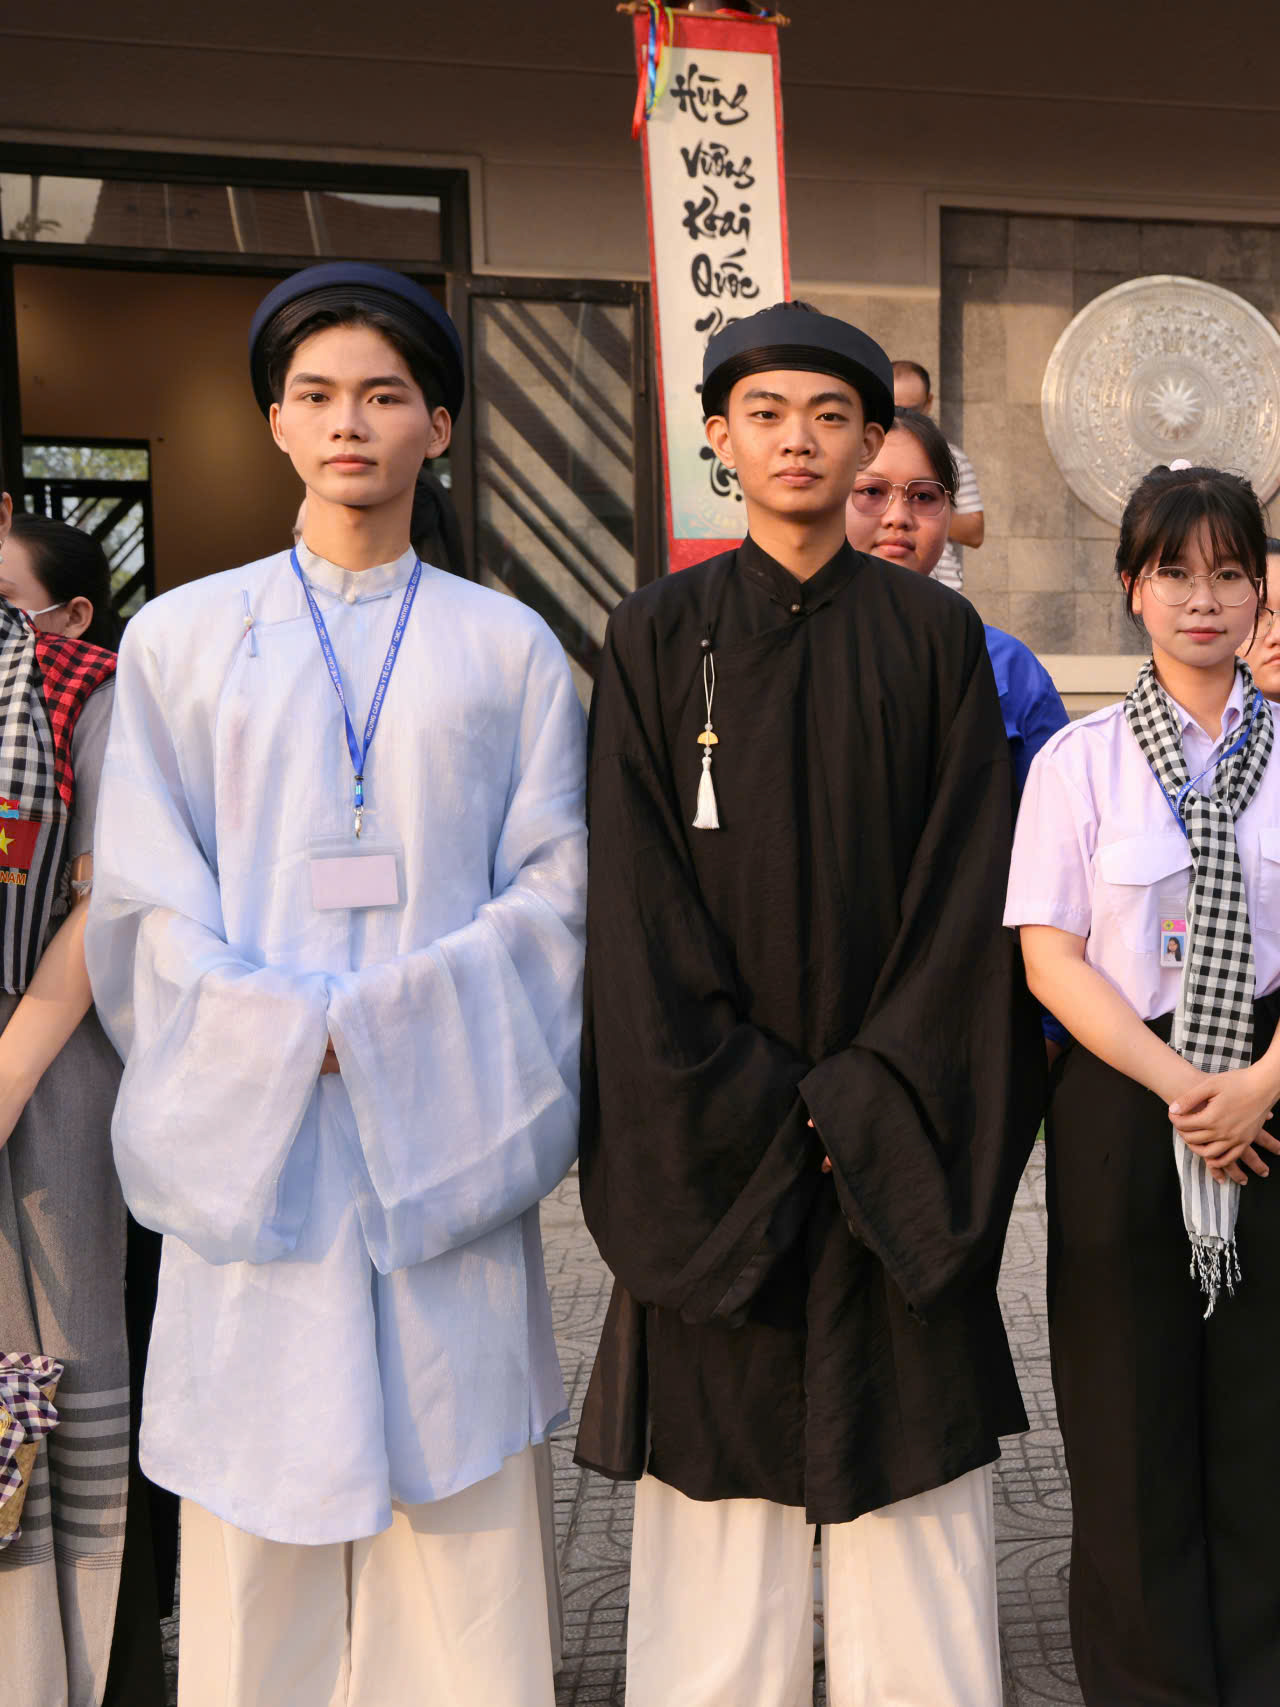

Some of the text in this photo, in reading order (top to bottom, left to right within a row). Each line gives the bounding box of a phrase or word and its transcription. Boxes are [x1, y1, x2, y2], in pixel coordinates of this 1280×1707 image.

[670, 64, 749, 126] Hùng
[682, 186, 751, 240] Khai
[691, 247, 760, 299] Quốc
[372, 701, 380, 715] CAO
[398, 604, 410, 627] CANTHO
[0, 870, 27, 886] NAM
